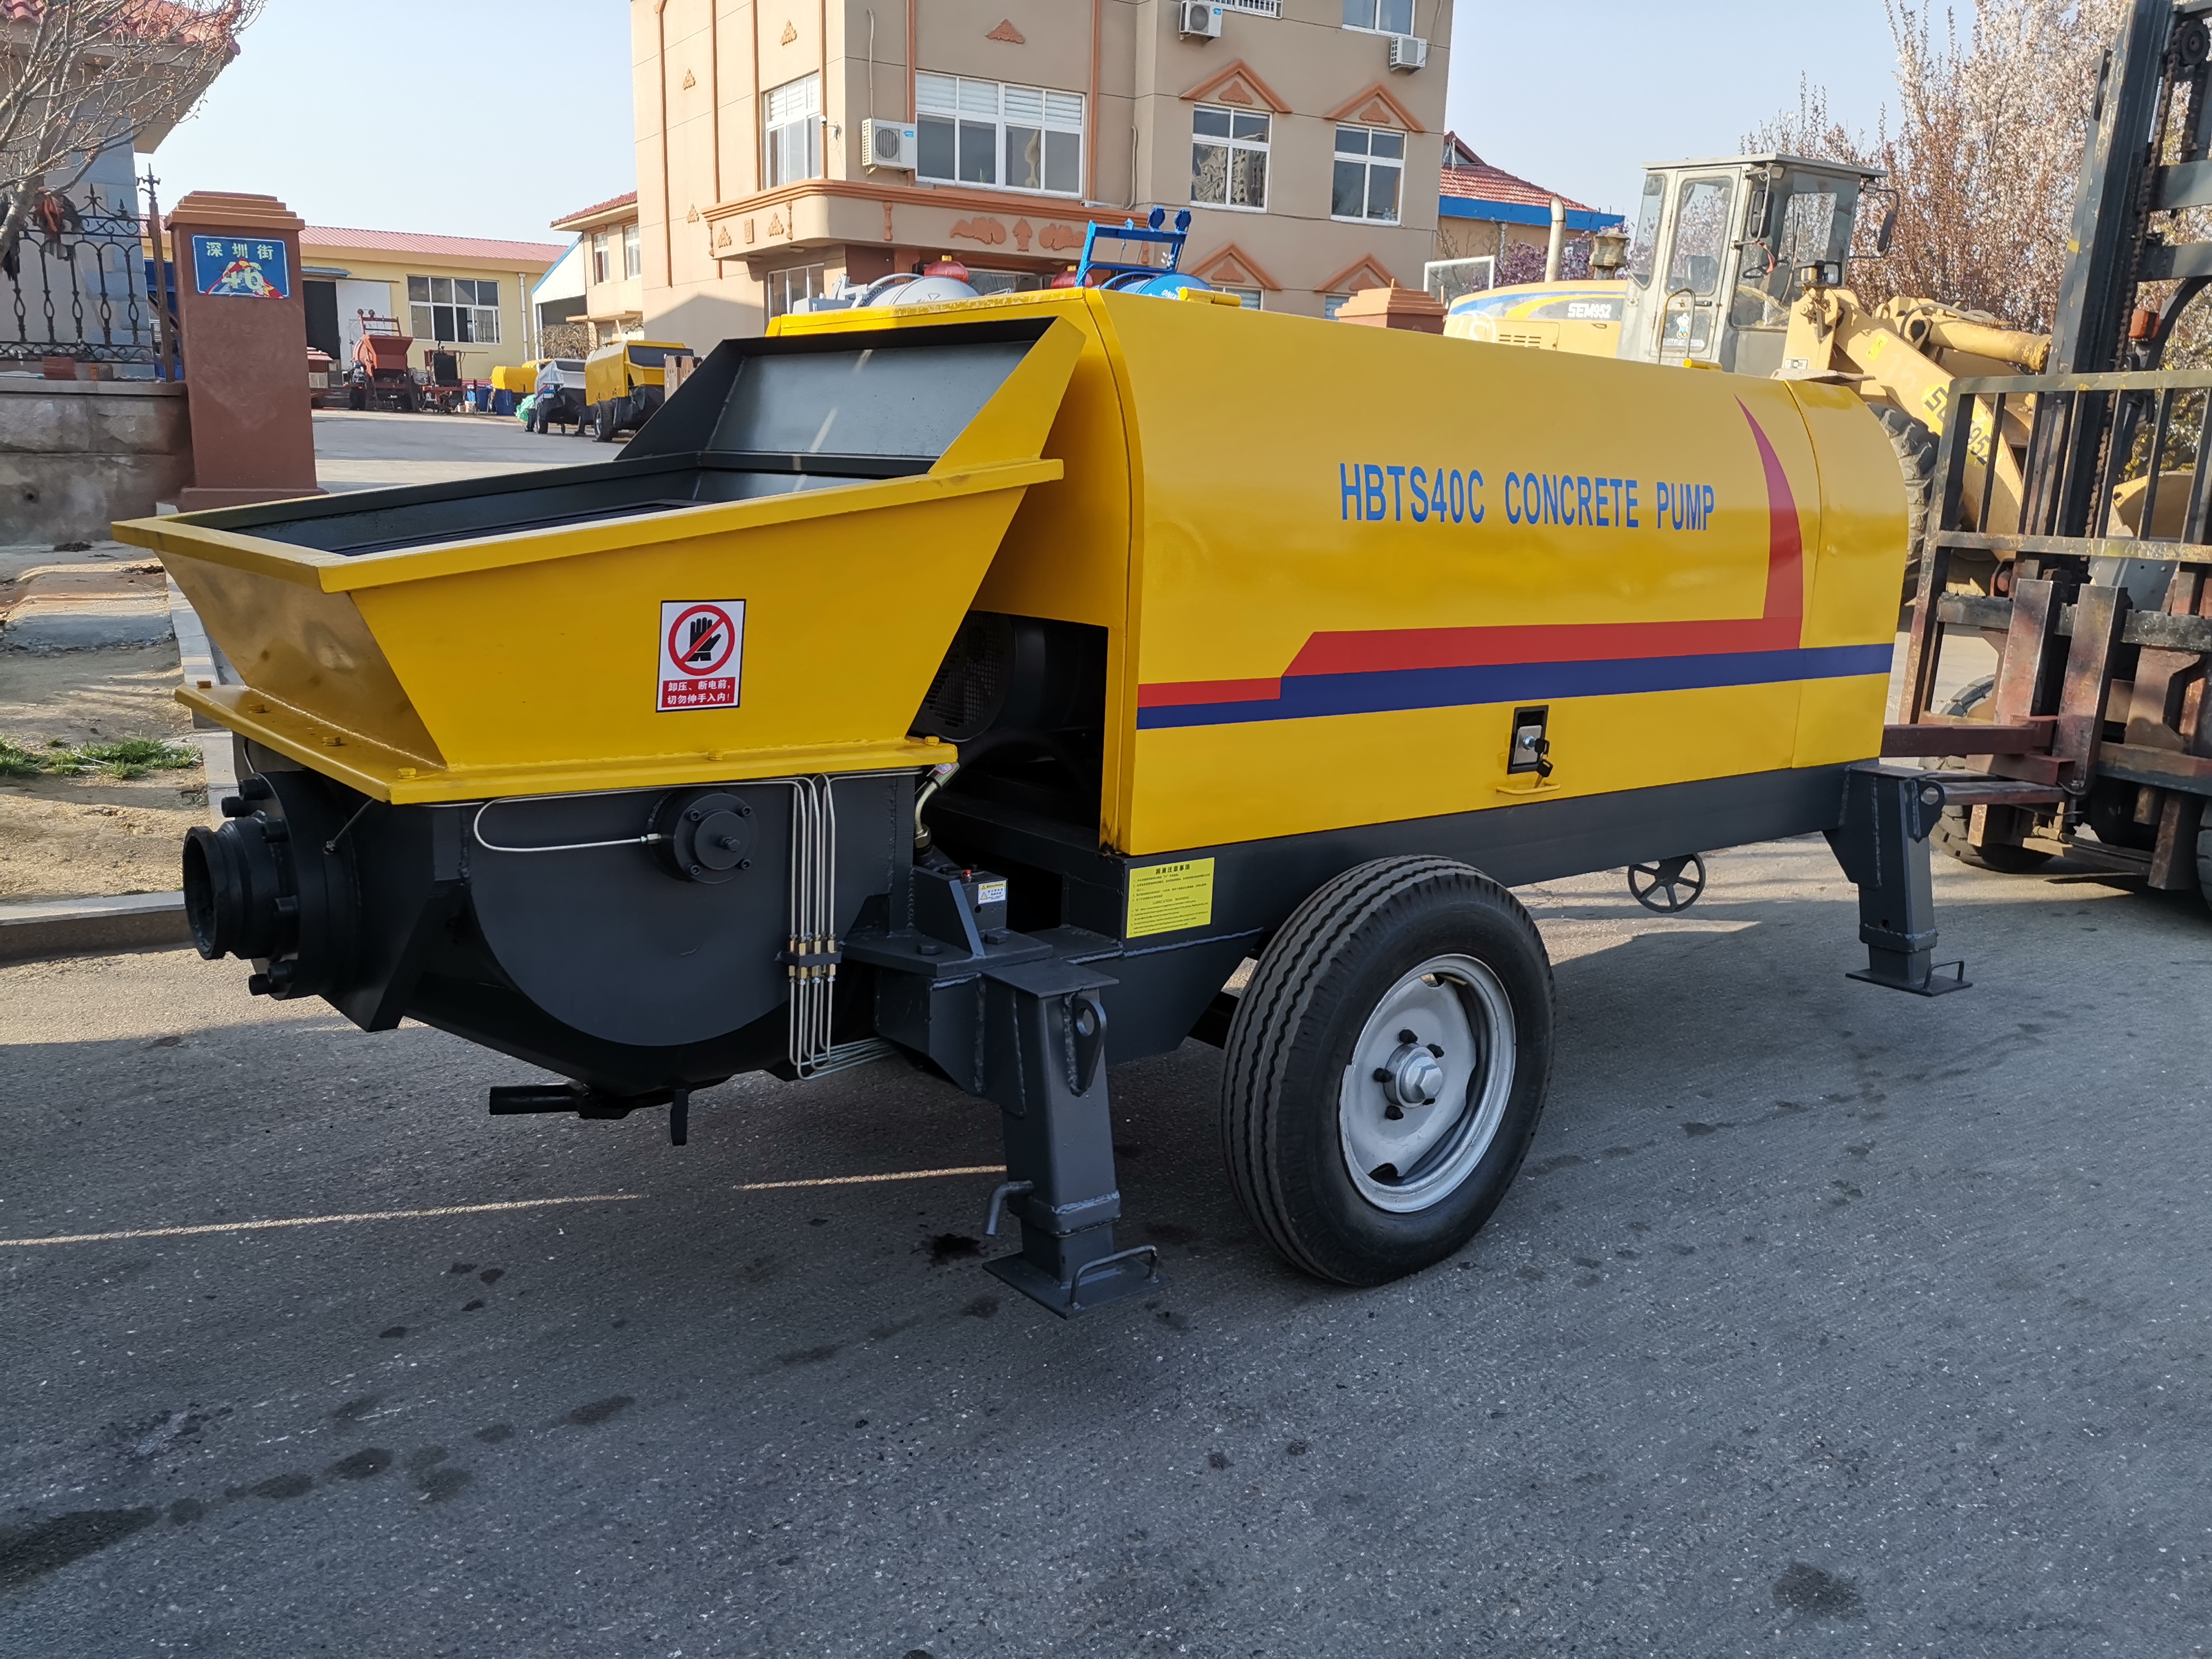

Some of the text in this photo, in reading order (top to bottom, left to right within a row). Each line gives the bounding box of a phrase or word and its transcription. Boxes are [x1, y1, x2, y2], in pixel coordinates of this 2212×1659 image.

[206, 241, 273, 260] 深圳街
[221, 261, 264, 290] 46
[1568, 303, 1612, 318] SEM952
[1339, 463, 1715, 531] HBTS40C CONCRETE PUMP
